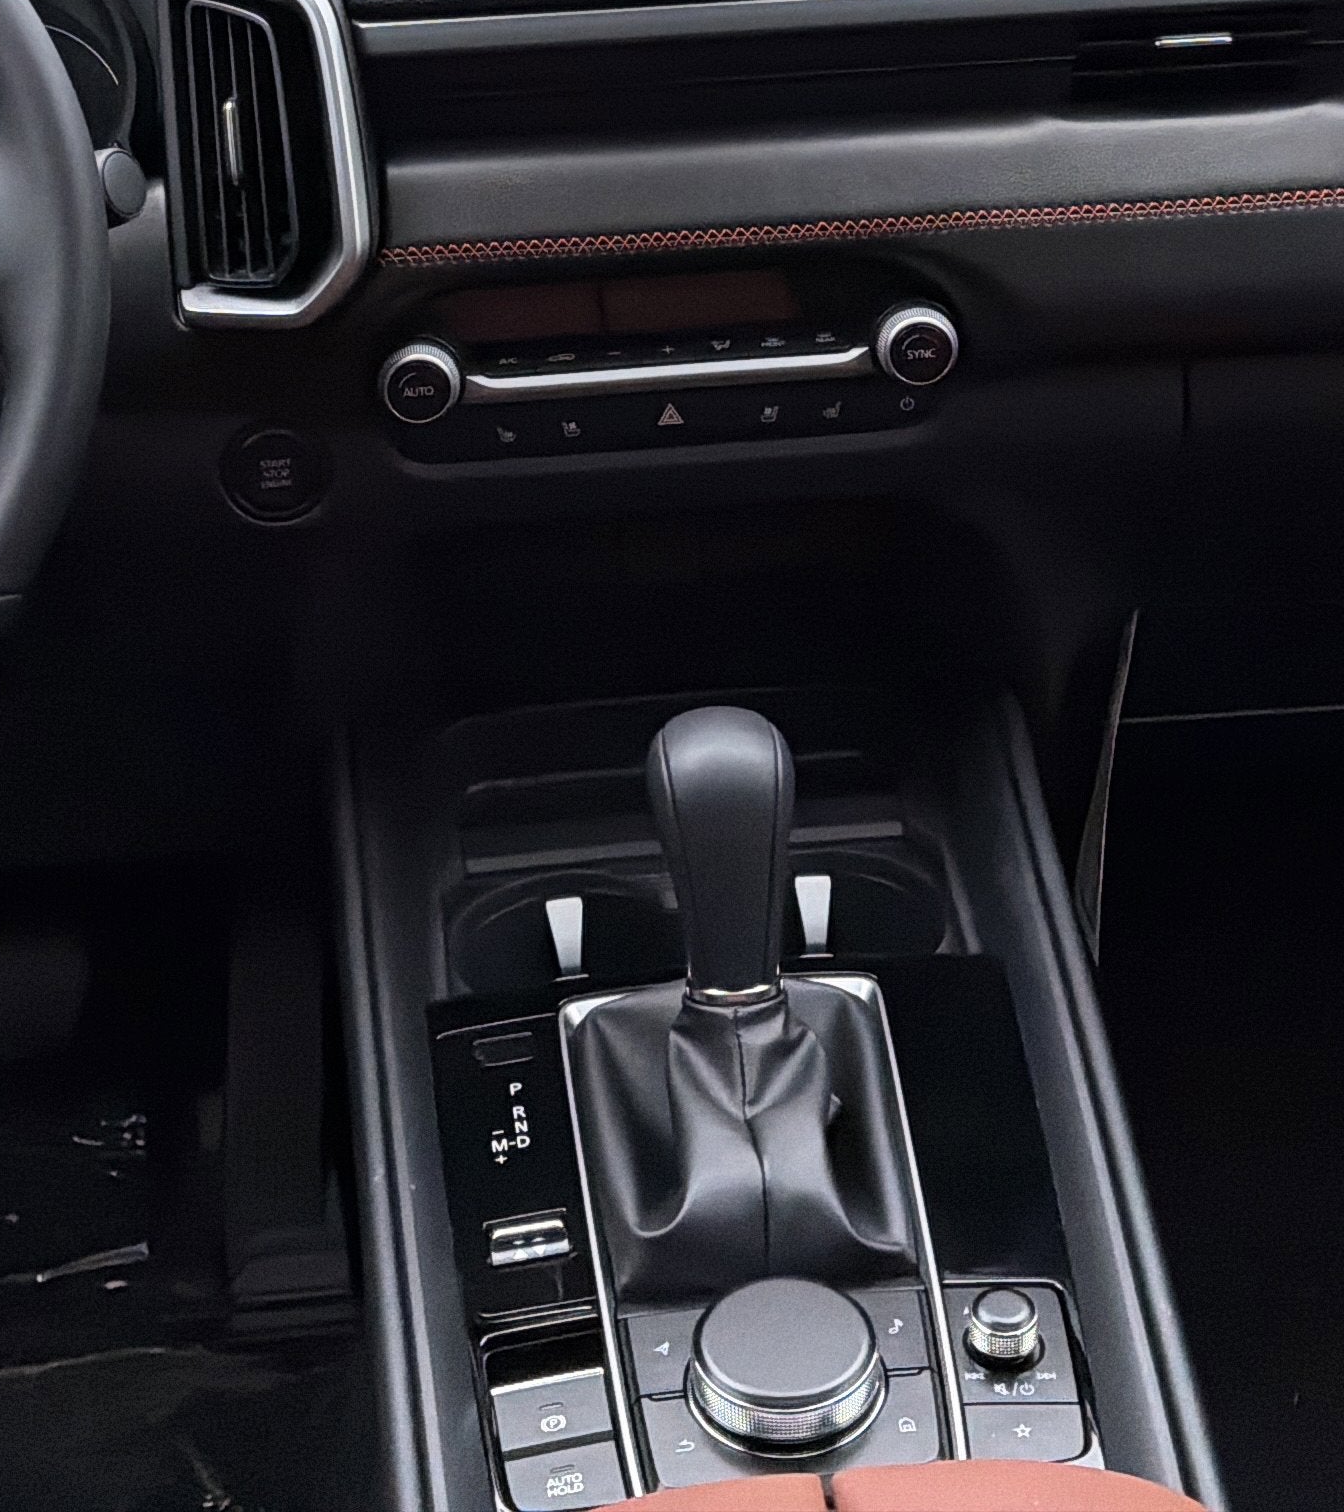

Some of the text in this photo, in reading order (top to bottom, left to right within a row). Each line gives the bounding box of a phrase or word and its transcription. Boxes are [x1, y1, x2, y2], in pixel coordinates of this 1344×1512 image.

[907, 349, 936, 360] SYNC
[403, 386, 434, 397] AUTO
[509, 1082, 523, 1096] P
[512, 1105, 526, 1119] R
[514, 1120, 528, 1133] N
[546, 1472, 583, 1489] AUTO
[547, 1482, 584, 1498] HOLD
